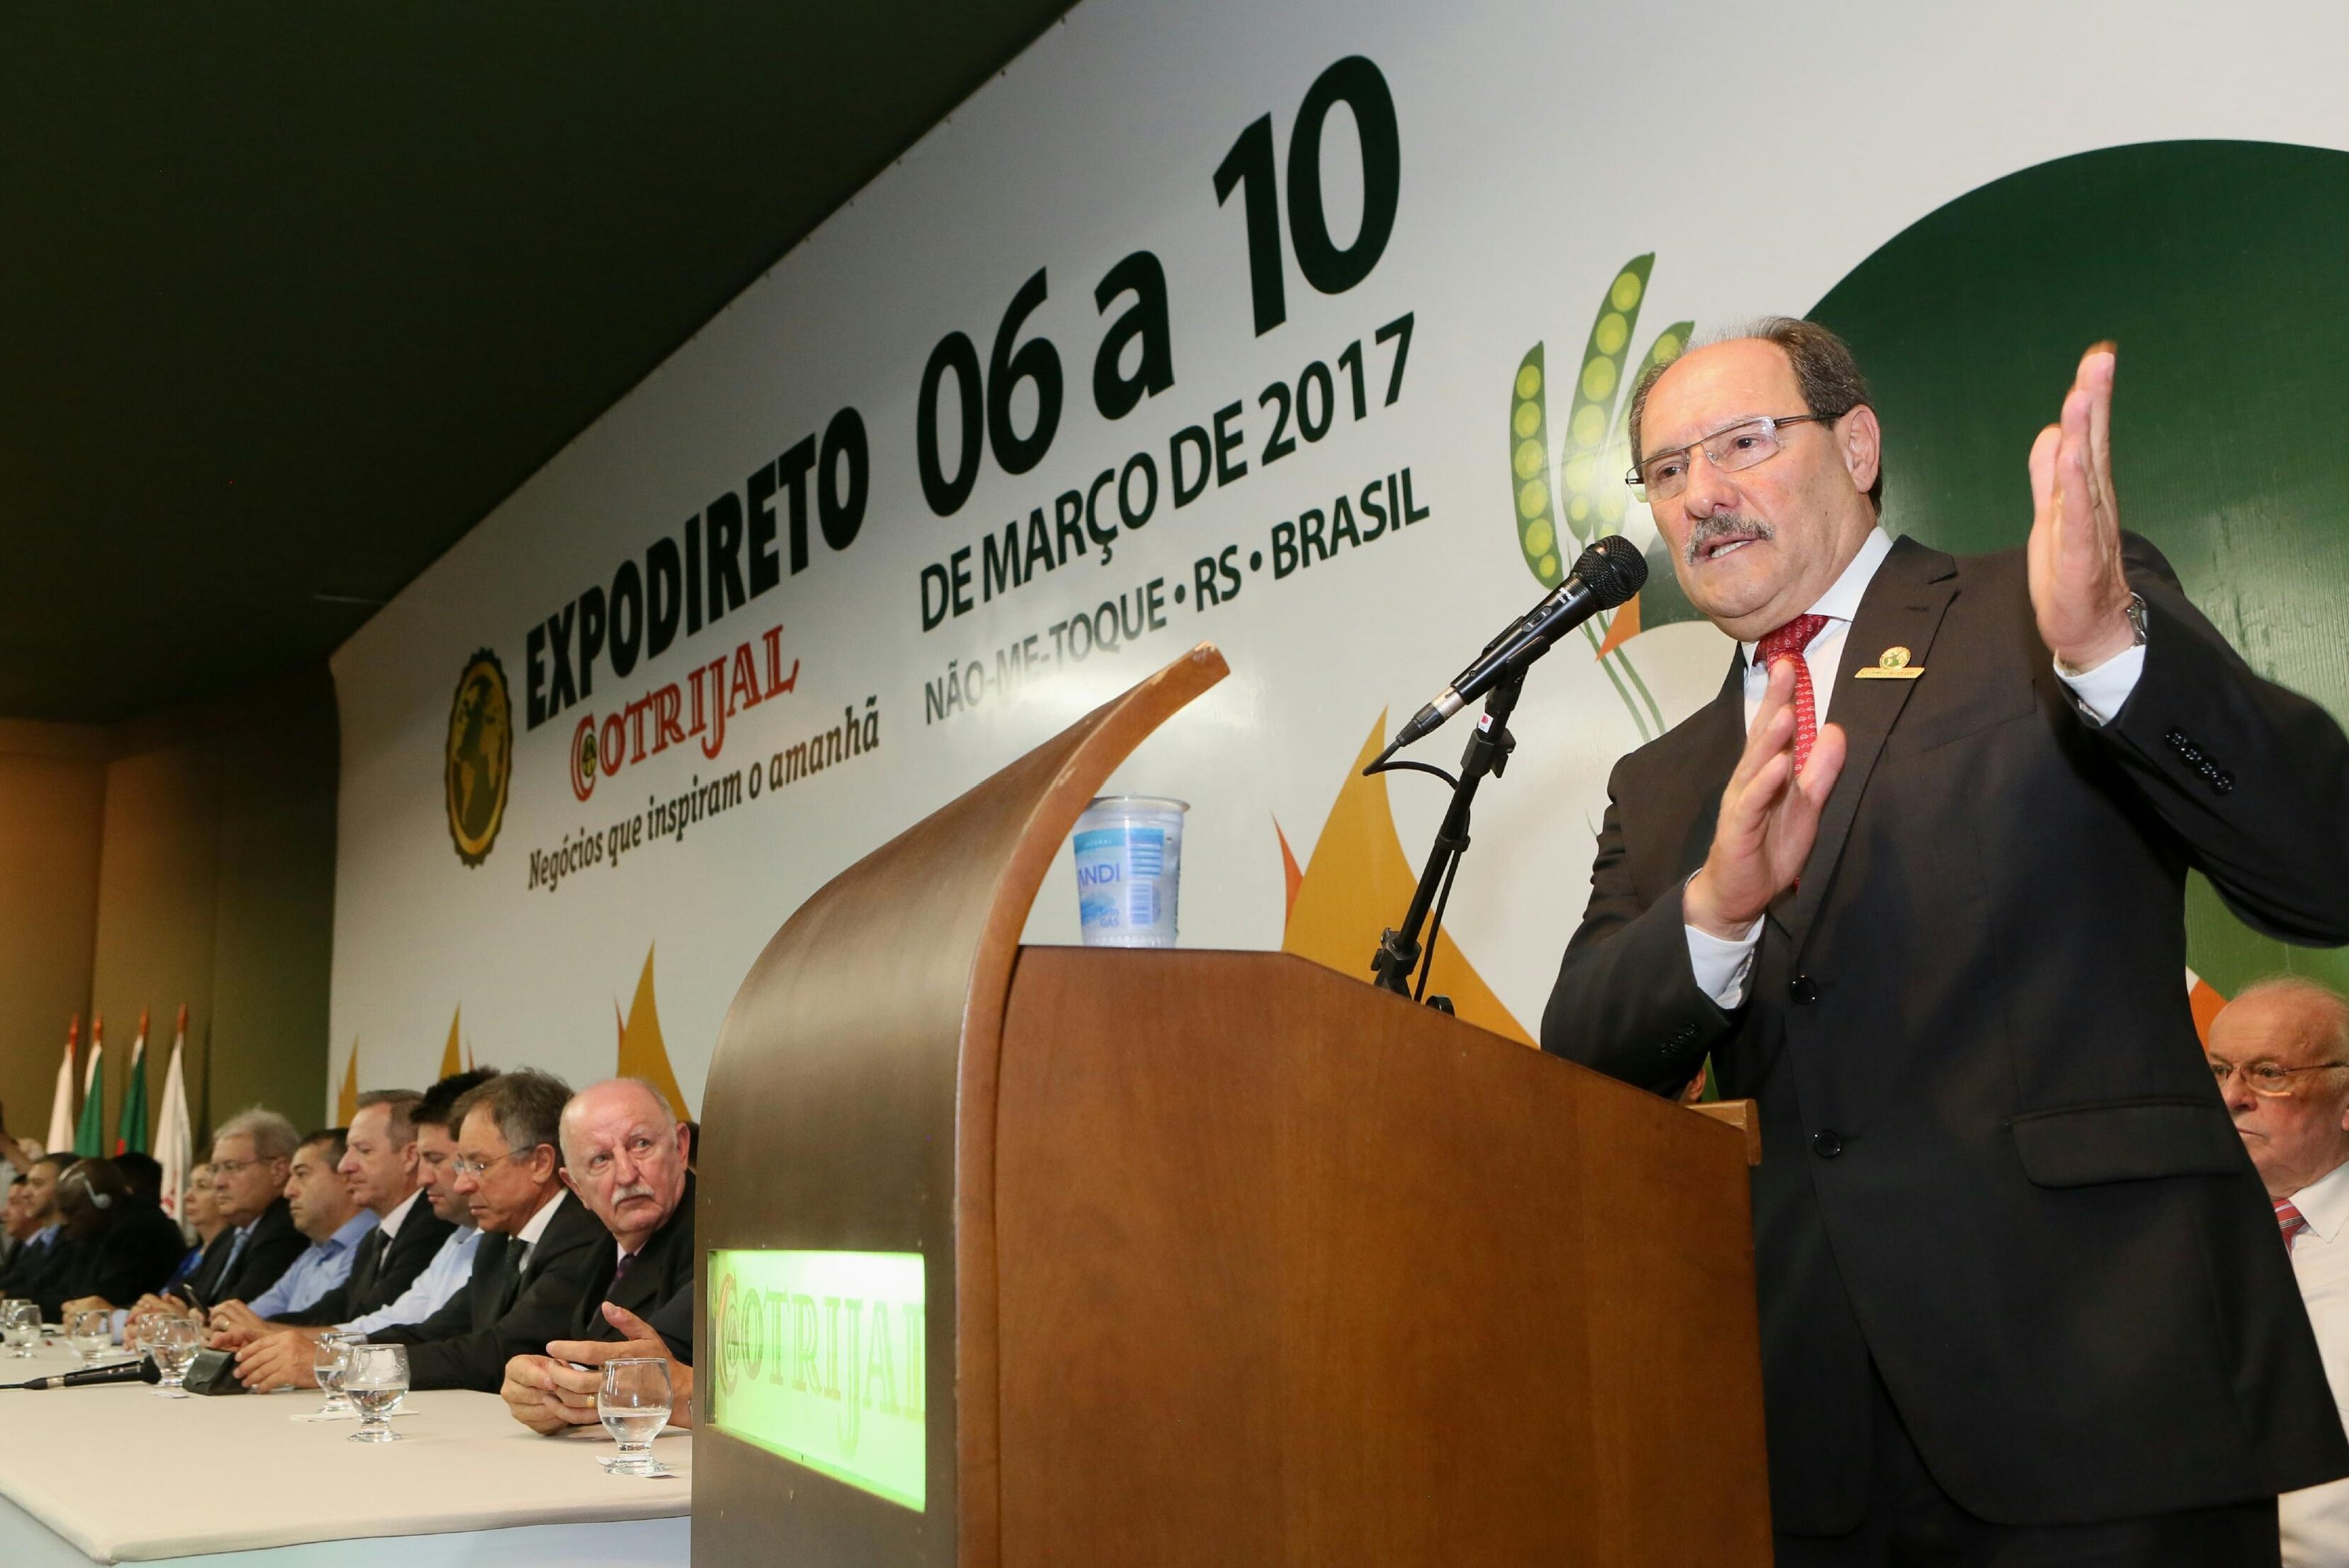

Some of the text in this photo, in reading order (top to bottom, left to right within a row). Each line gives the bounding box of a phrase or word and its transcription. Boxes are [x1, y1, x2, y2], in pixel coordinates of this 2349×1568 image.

[916, 55, 1401, 518] 06 a 10
[526, 406, 870, 732] EXPODIRETO
[920, 310, 1415, 632] DE MARÇO DE 2017
[924, 467, 1430, 725] NÃO-ME-TOQUE RS BRASIL
[528, 694, 880, 892] Negócios que inspiram o amanhã
[570, 624, 799, 801] COTRIJAL
